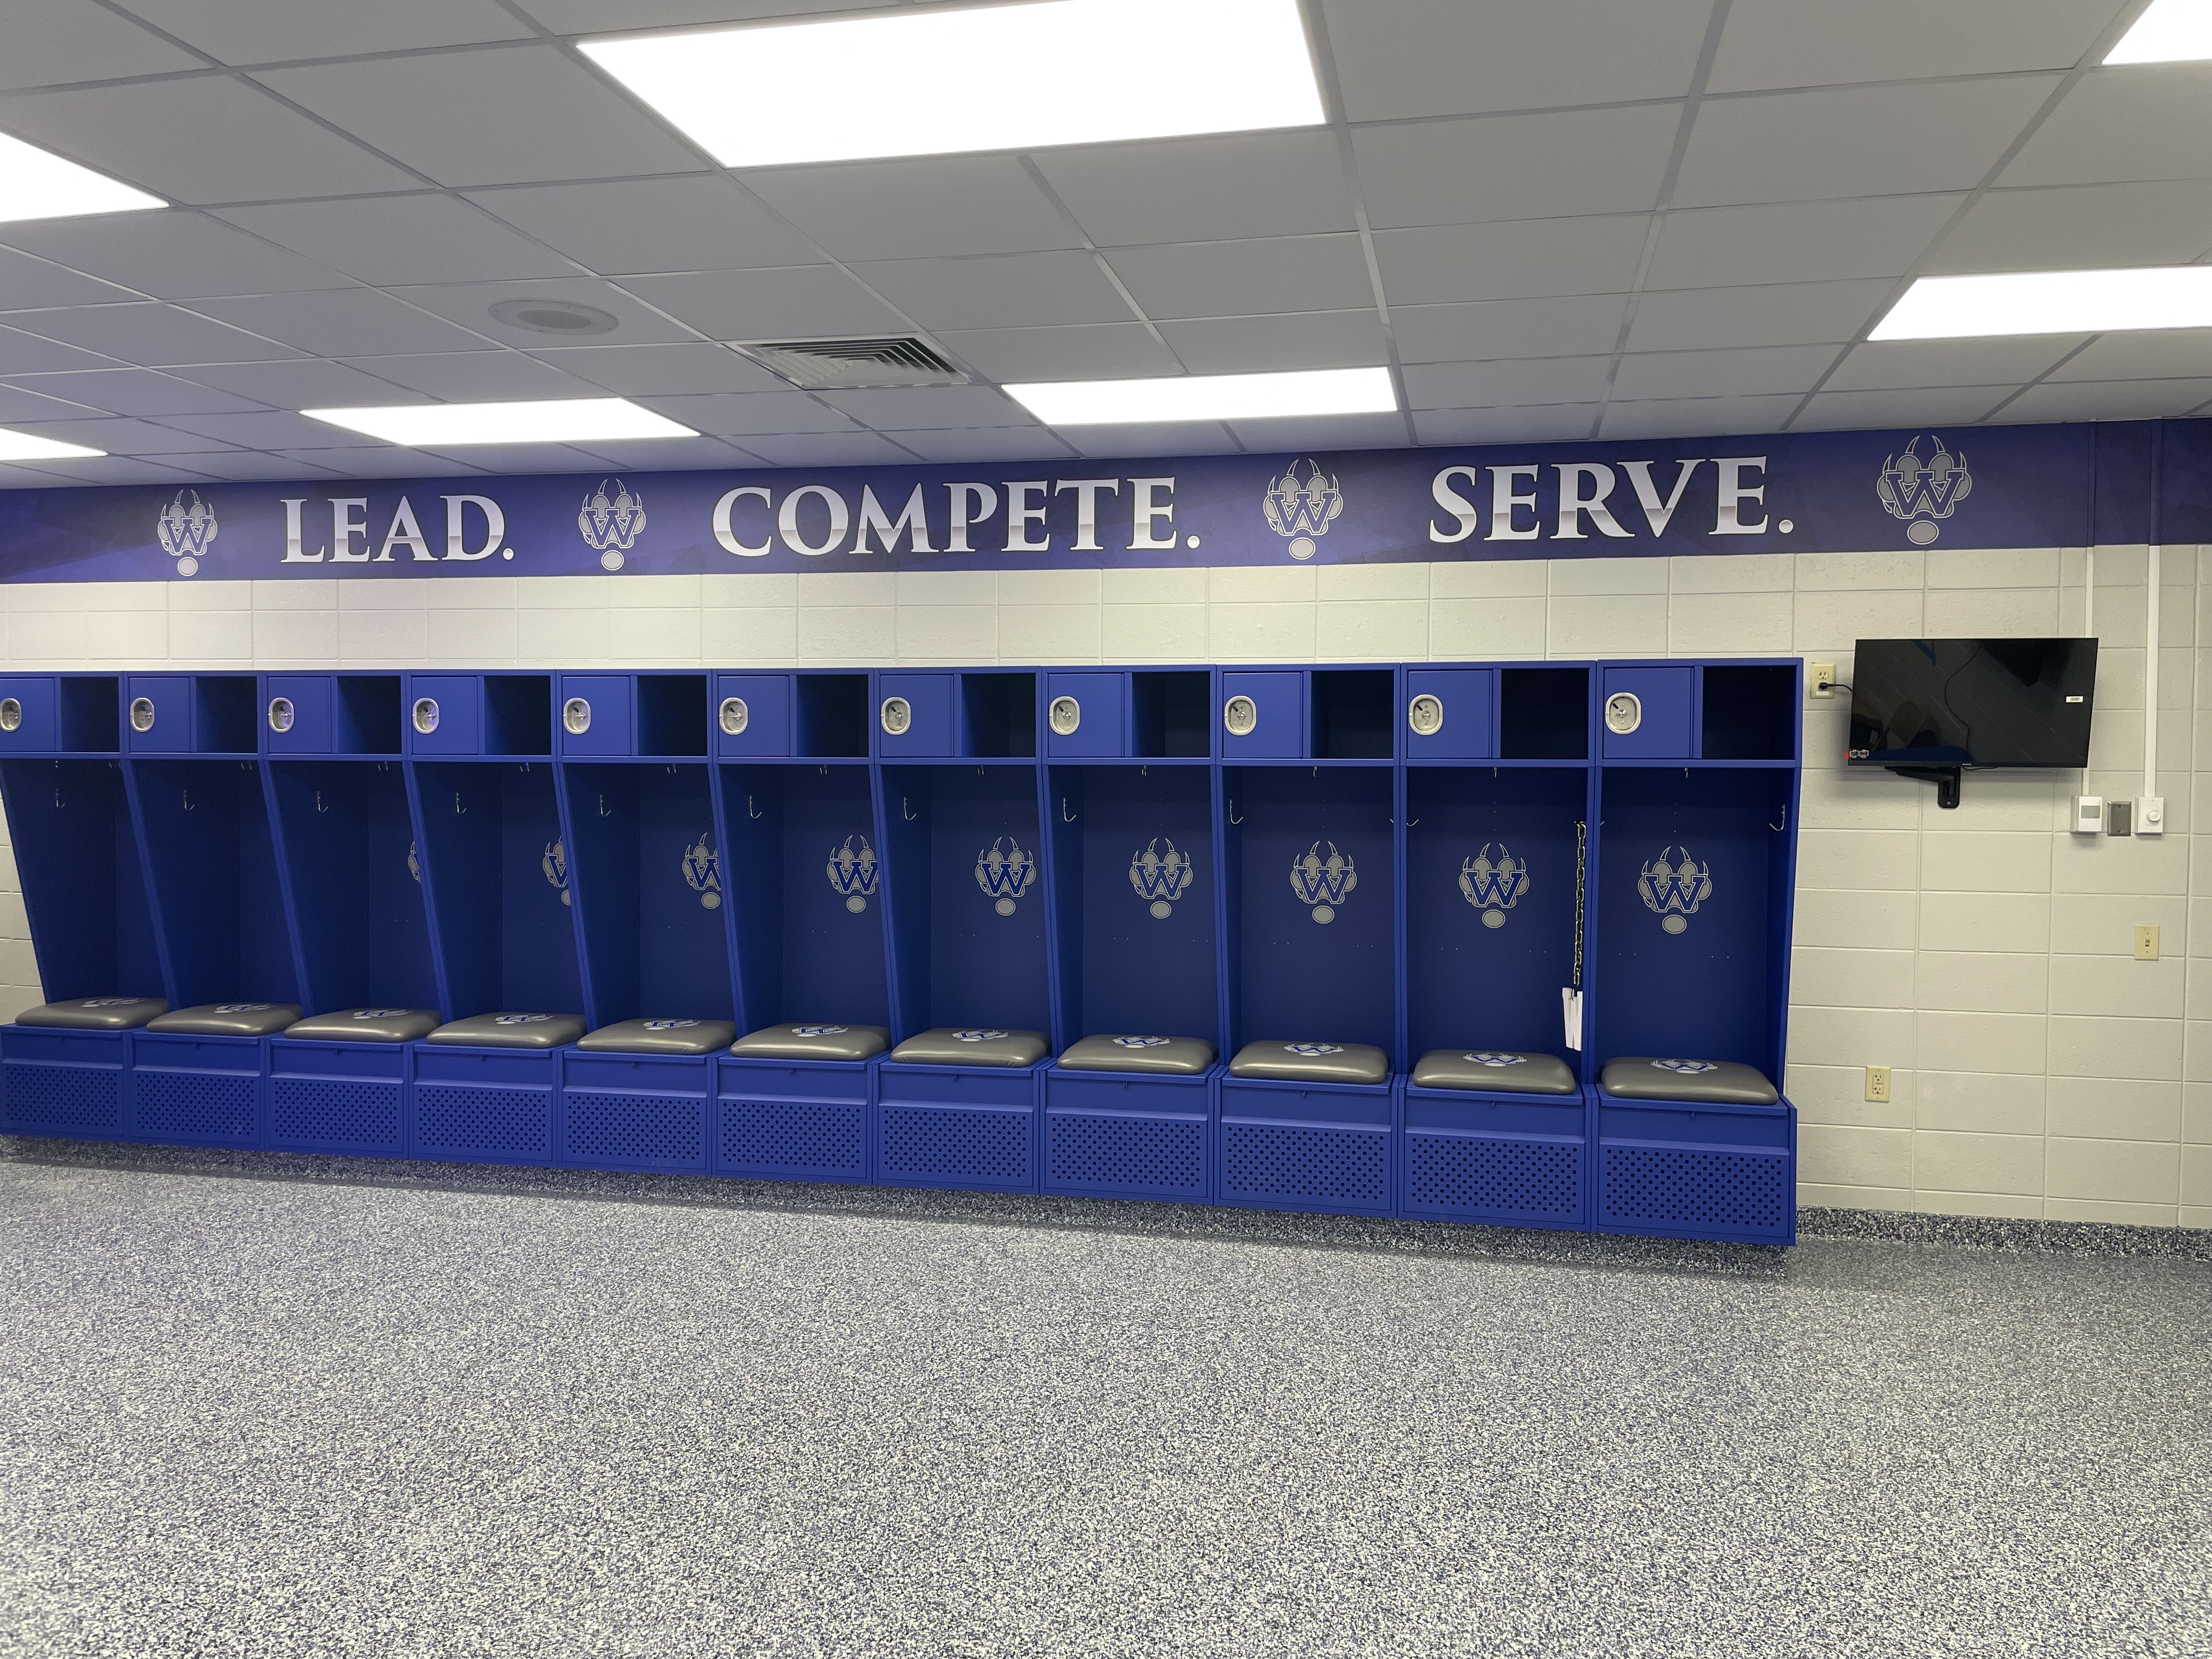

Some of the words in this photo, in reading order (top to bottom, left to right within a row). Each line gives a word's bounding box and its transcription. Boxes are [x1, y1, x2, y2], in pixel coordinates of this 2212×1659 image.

[1269, 490, 1337, 535] W
[1429, 455, 1794, 543] SERVE.
[1885, 470, 1964, 519] W
[162, 517, 213, 555] W
[280, 495, 515, 563] LEAD.
[584, 508, 641, 549] W
[712, 477, 1201, 557] COMPETE.
[832, 860, 879, 894] W
[979, 861, 1032, 897] W
[1135, 862, 1188, 900] W
[1296, 867, 1353, 904] W
[1465, 870, 1525, 909] W
[1644, 874, 1707, 913] W
